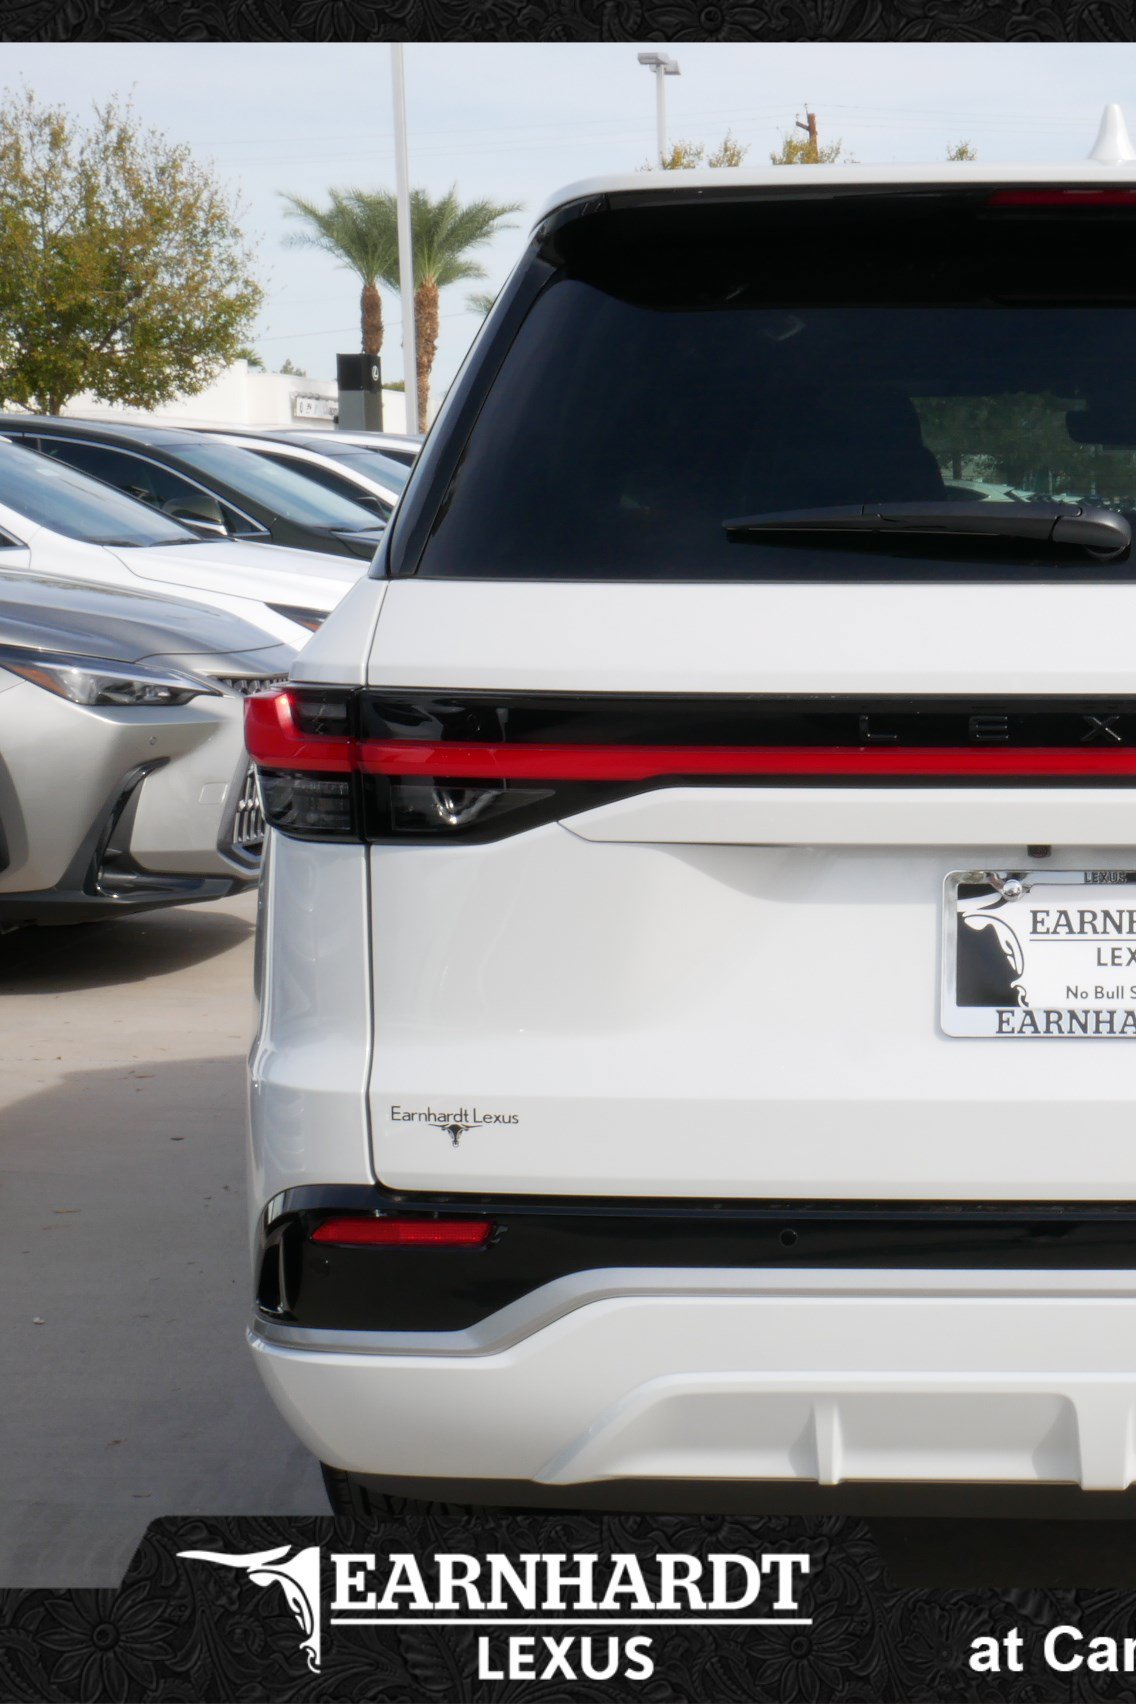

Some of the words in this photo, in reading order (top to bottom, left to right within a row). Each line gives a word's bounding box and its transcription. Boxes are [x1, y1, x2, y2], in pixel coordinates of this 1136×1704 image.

[1083, 871, 1128, 883] LEXUS
[1066, 986, 1088, 1000] No
[1094, 985, 1124, 1000] Bull
[391, 1105, 469, 1123] Earnhardt
[473, 1108, 519, 1124] Lexus
